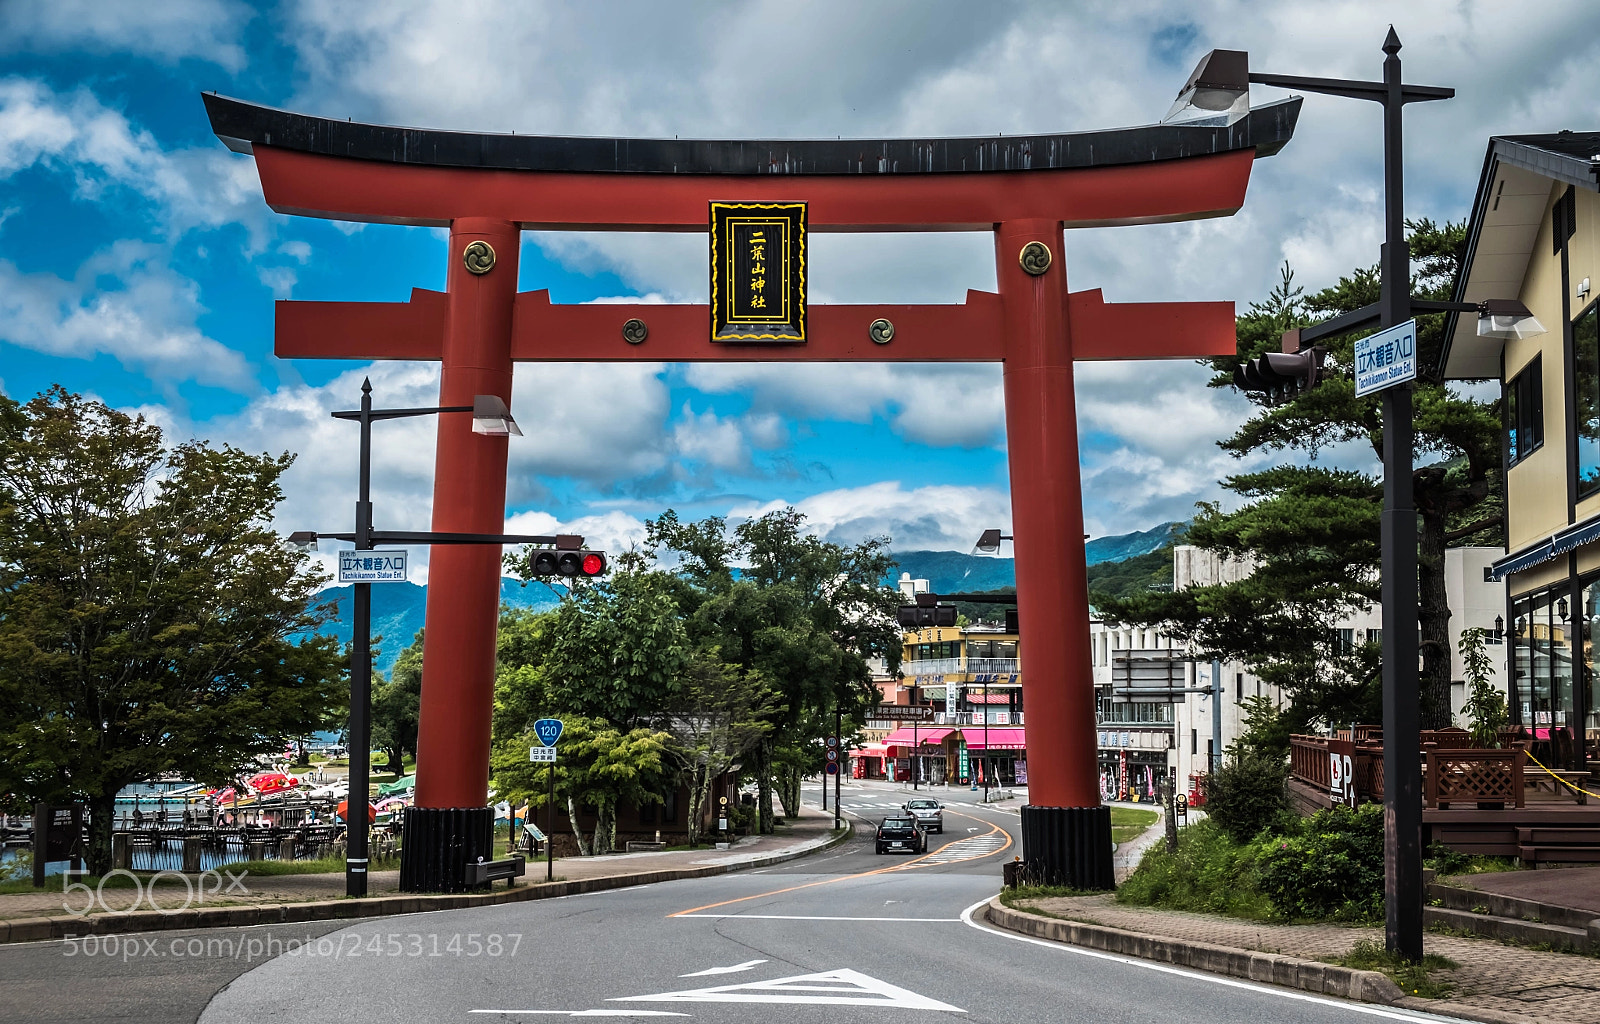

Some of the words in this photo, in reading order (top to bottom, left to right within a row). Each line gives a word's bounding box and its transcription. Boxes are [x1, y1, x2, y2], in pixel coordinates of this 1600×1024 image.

[749, 231, 767, 309] 二荒山神社
[1358, 334, 1413, 375] 立木観音入口
[1358, 371, 1388, 389] Tachikikannon
[1389, 364, 1403, 379] Statue
[1403, 360, 1413, 374] Ent.
[342, 557, 404, 571] 立木観音入口
[377, 571, 393, 579] Statue
[393, 571, 404, 579] Ent.
[540, 726, 557, 736] 120
[1343, 754, 1353, 800] P
